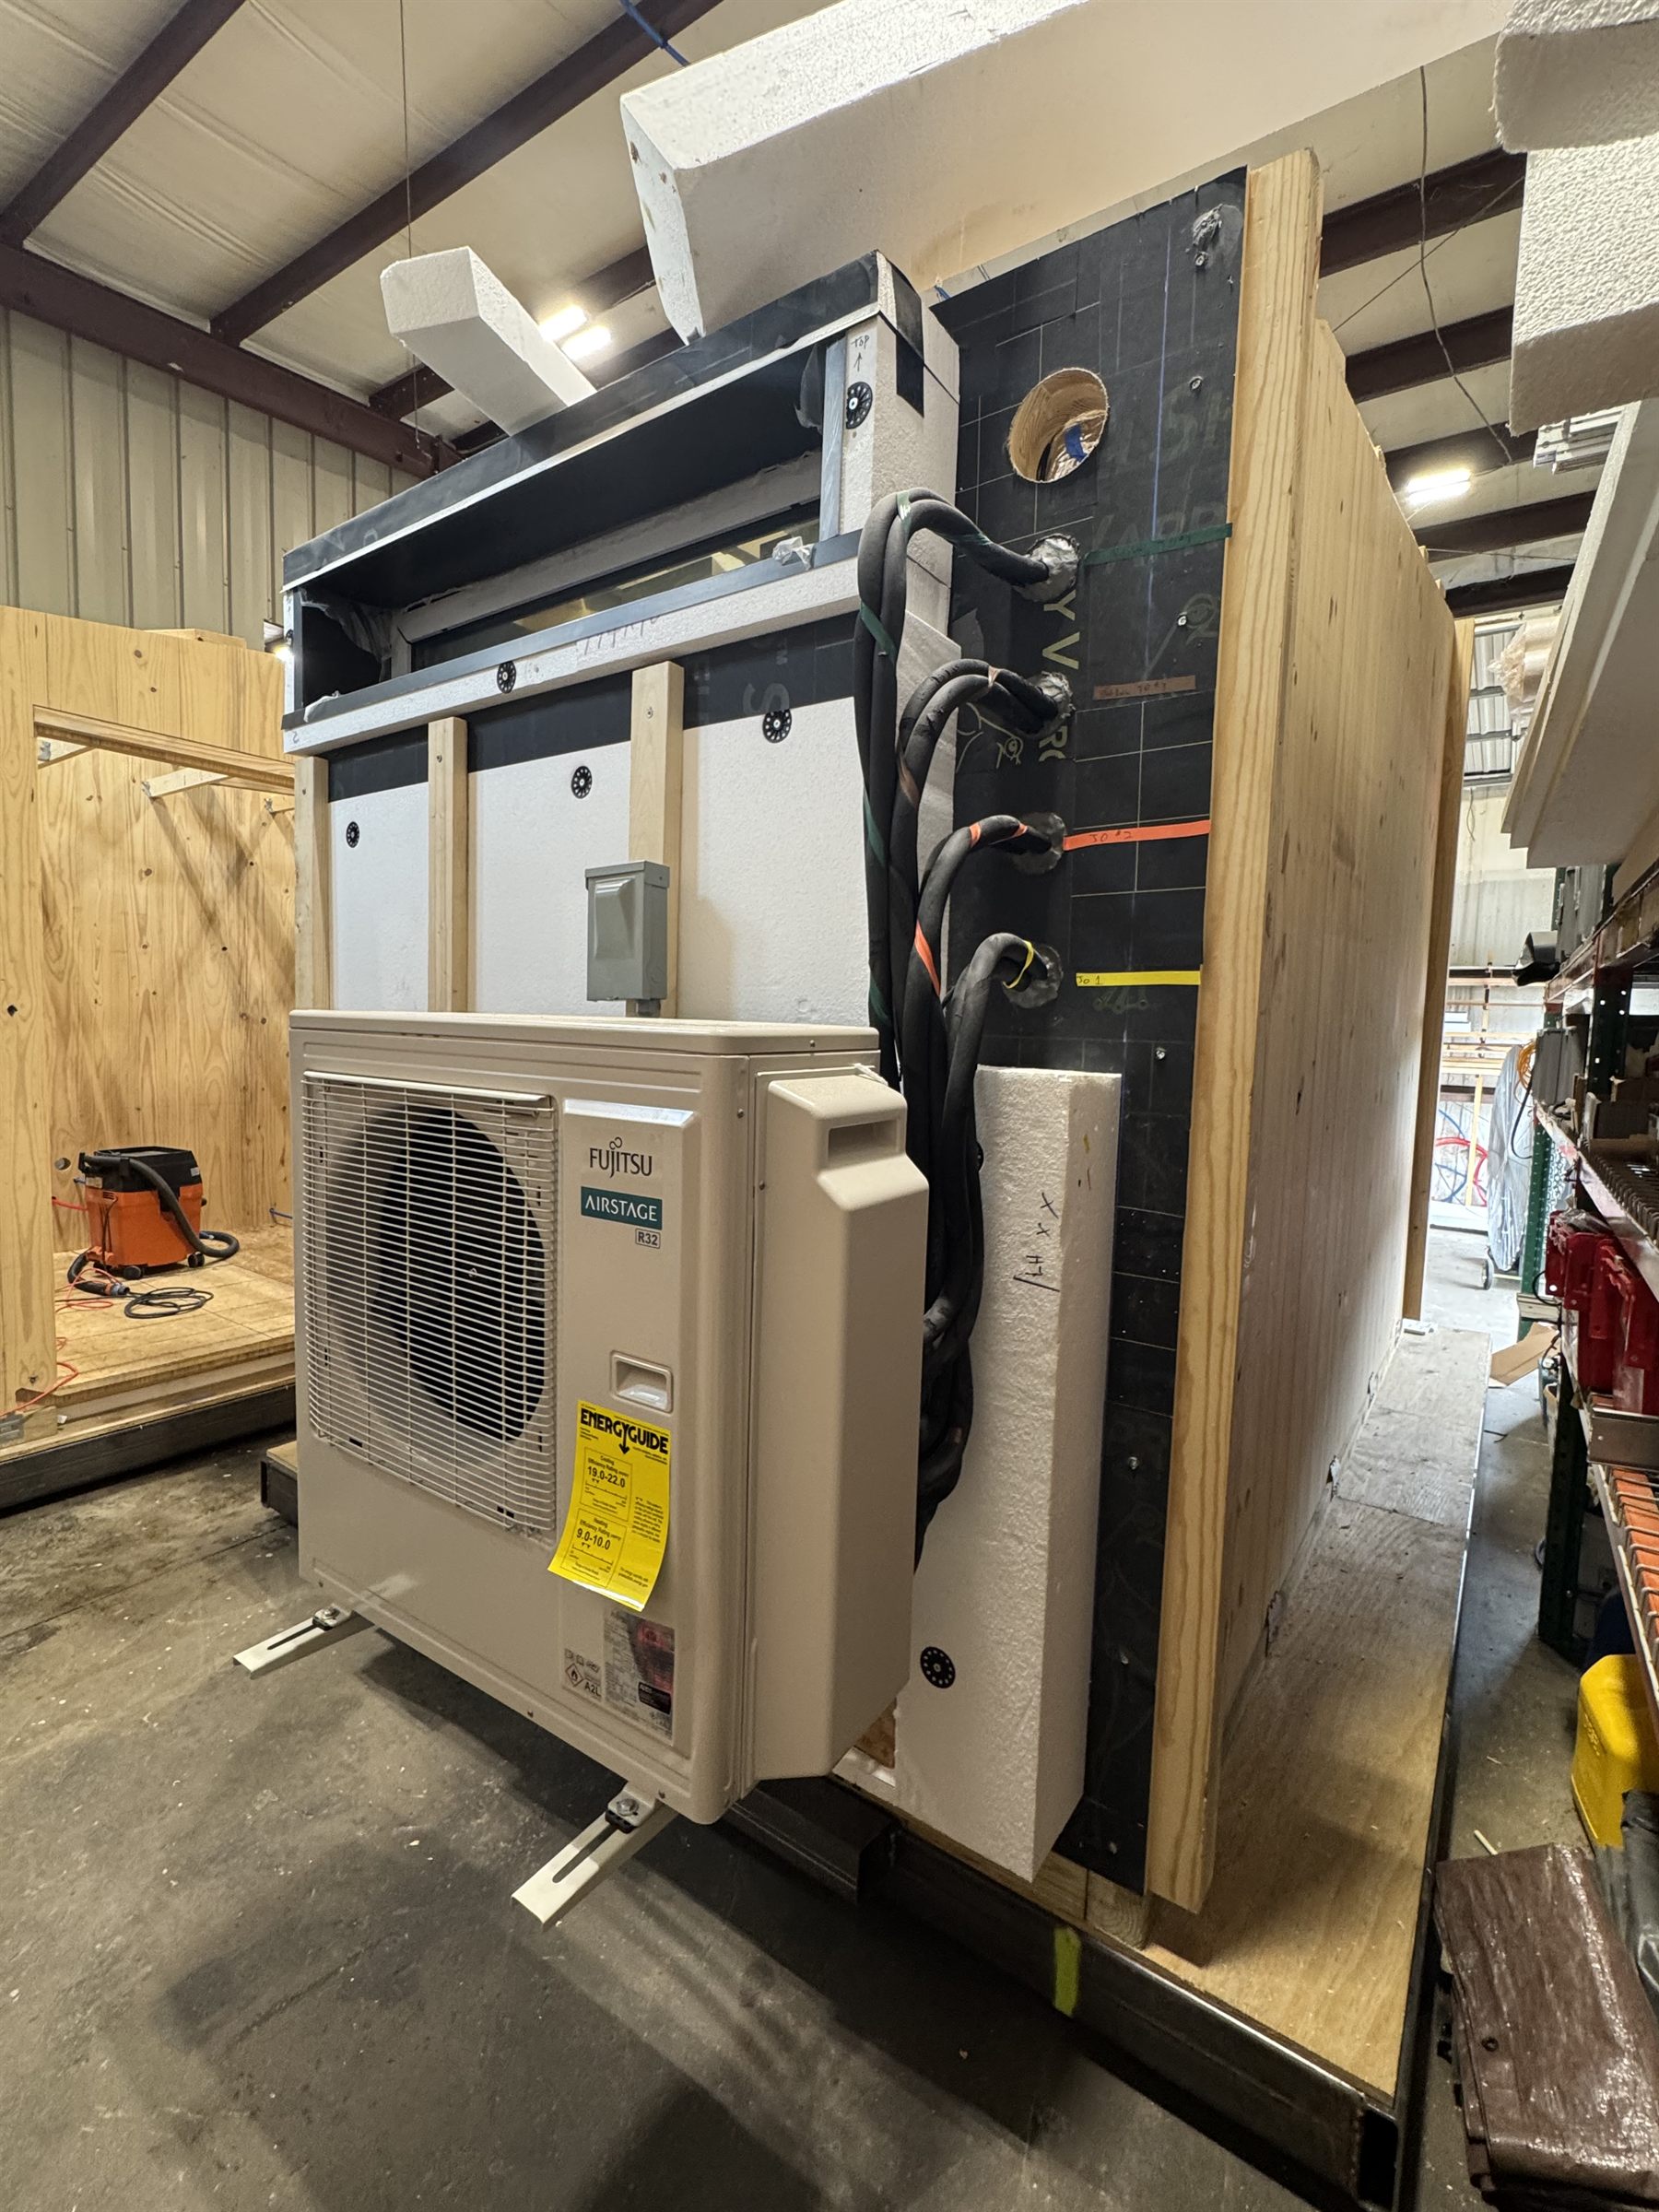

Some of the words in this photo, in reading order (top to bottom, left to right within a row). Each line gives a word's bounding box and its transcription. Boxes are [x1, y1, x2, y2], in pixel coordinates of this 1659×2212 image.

[851, 335, 870, 349] TOP
[589, 1136, 653, 1178] FUJITSU
[585, 1194, 658, 1222] AIRSTAGE
[638, 1231, 658, 1246] R32
[581, 1407, 669, 1454] ENERGYGUIDE
[587, 1465, 626, 1488] 19.0-22.0
[576, 1527, 611, 1550] 9.0-10.0
[584, 1681, 601, 1698] A2L
